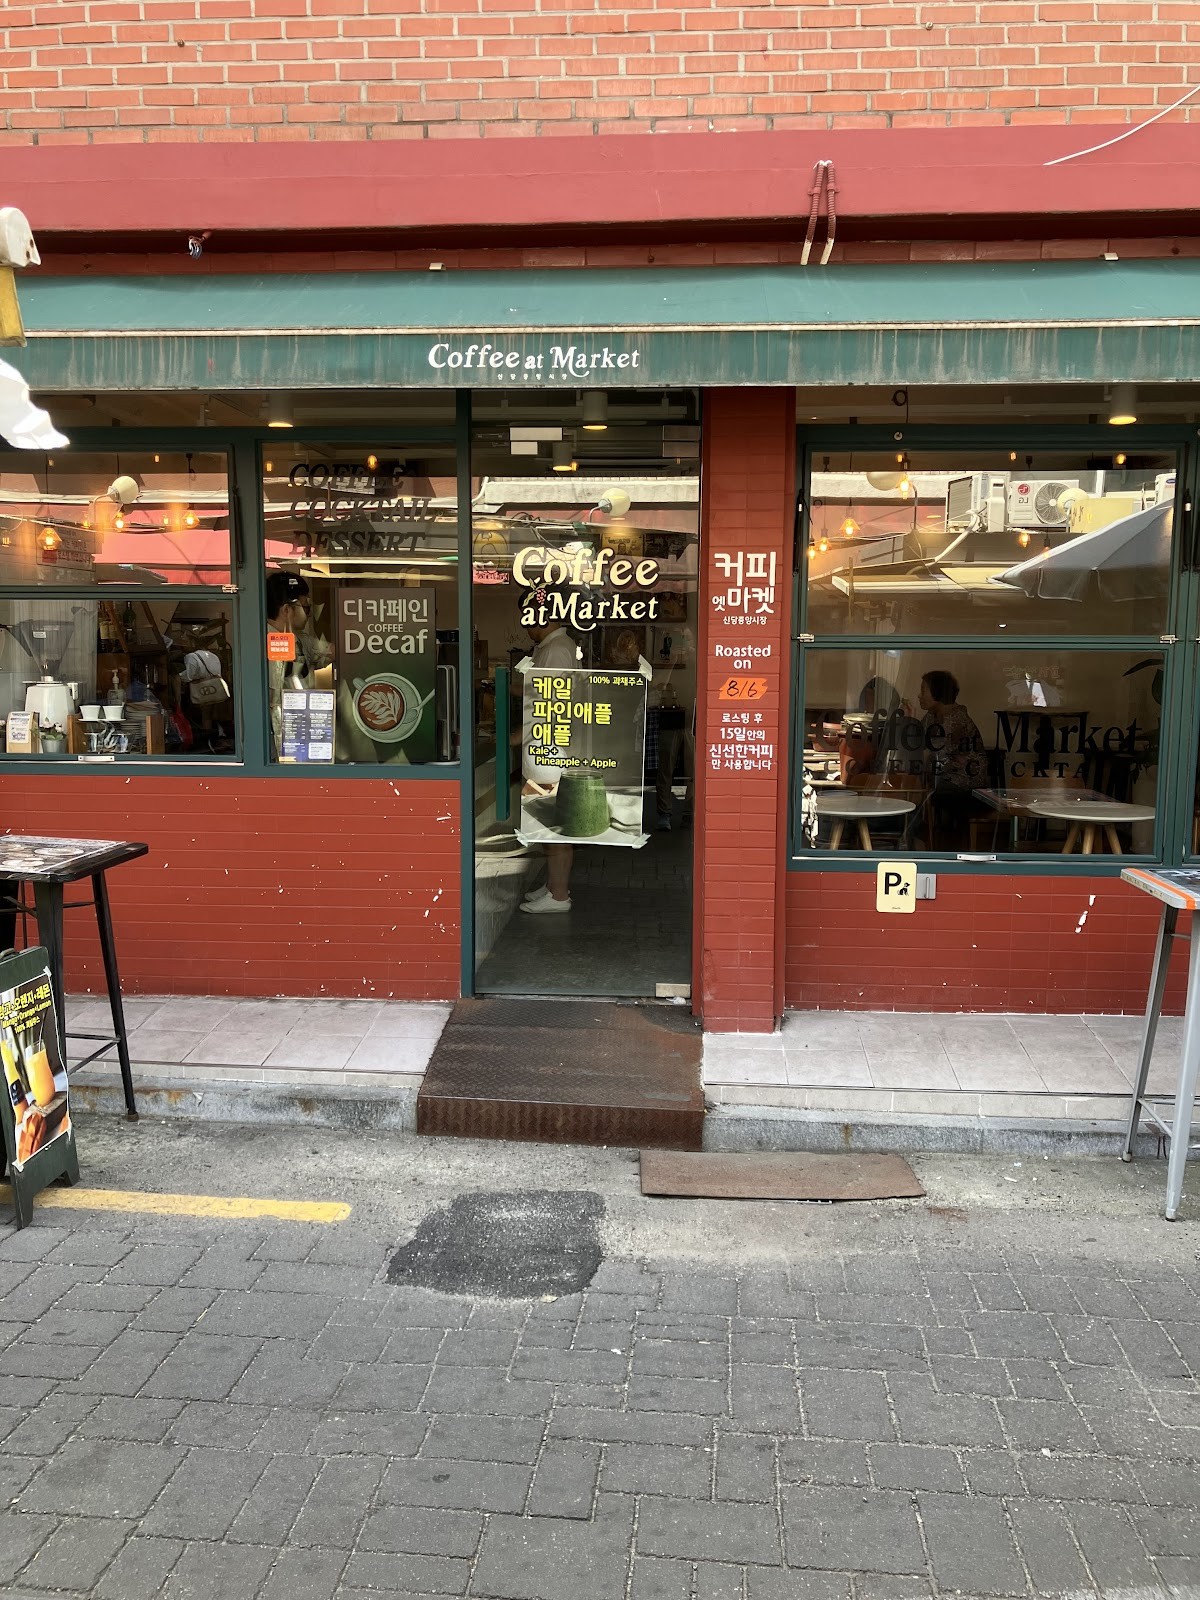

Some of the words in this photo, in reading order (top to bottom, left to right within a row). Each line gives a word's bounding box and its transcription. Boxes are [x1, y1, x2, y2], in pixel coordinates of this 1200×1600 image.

[428, 343, 519, 368] Coffee
[524, 353, 544, 369] at
[550, 346, 640, 378] Market
[289, 463, 405, 489] COFFEE
[290, 497, 436, 522] COCKTAIL
[289, 531, 426, 556] DESSERT
[512, 546, 659, 587] Coffee
[714, 551, 776, 587] 커피
[343, 599, 428, 622] 디카페인
[520, 605, 549, 626] at
[547, 592, 659, 632] Market
[723, 616, 767, 625] 신당중앙시장
[367, 623, 403, 633] COFFEE
[344, 628, 428, 654] Decaf
[715, 645, 771, 657] Roasted
[733, 659, 752, 669] on
[532, 677, 572, 700] 케일
[588, 676, 610, 684] 100%
[612, 677, 644, 686] 과채주스
[726, 680, 758, 698] 8/6
[533, 701, 612, 725] 파인애플
[722, 713, 750, 724] 로스팅
[753, 713, 763, 724] 후
[532, 723, 571, 746] 애플
[720, 727, 765, 741] 15일안의
[994, 711, 1142, 754] Market
[529, 747, 549, 755] Kale
[536, 757, 580, 767] Pineapple
[590, 759, 617, 768] Apple
[709, 744, 773, 759] 신선한커피
[711, 760, 721, 770] 만
[724, 760, 772, 771] 사용합니다
[884, 872, 902, 895] P
